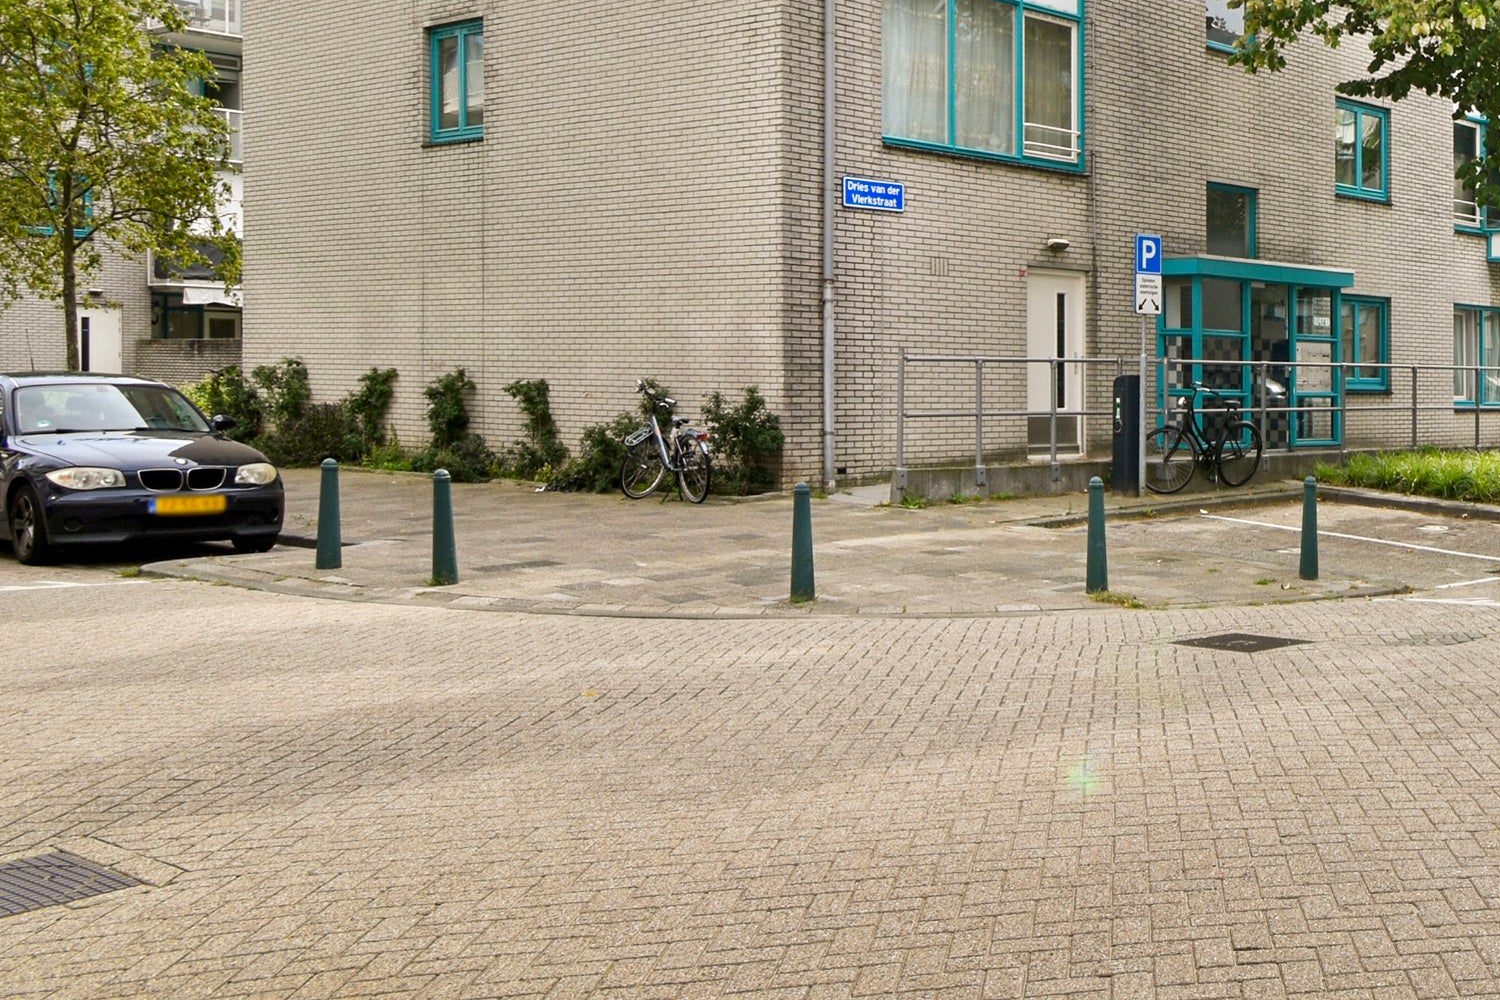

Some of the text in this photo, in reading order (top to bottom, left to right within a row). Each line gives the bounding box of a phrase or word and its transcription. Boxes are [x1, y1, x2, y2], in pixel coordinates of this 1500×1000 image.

[847, 181, 900, 195] Dries van der
[851, 193, 897, 207] Vlerkstraat
[1142, 239, 1156, 269] P
